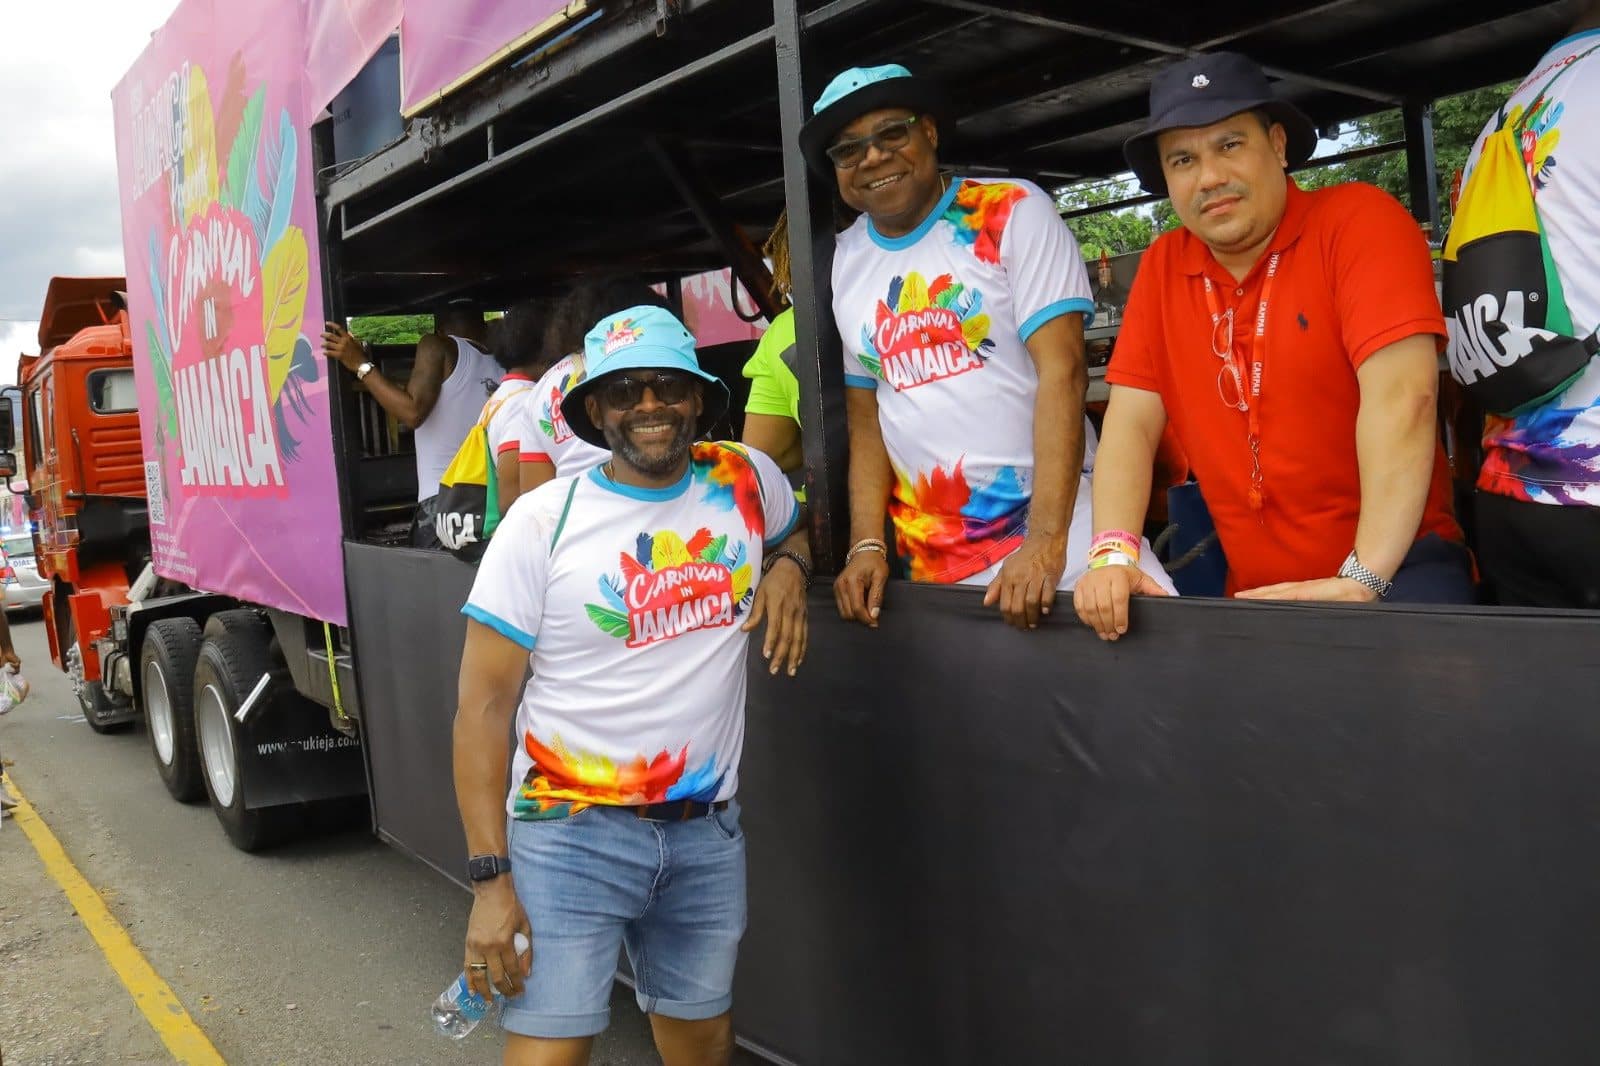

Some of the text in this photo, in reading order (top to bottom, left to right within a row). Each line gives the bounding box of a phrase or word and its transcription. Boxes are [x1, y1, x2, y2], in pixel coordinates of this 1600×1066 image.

[168, 215, 257, 353] CARNIVAL
[203, 296, 217, 340] IN
[877, 312, 956, 353] CARNIVAL
[920, 332, 931, 345] IN
[1256, 301, 1268, 336] CAMPARI
[884, 341, 982, 390] JAMAICA
[1252, 361, 1263, 396] CAMPARI
[175, 345, 285, 487] JAMAICA
[629, 565, 726, 609] CARNIVAL
[680, 586, 693, 598] IN
[630, 592, 733, 645] JAMAICA
